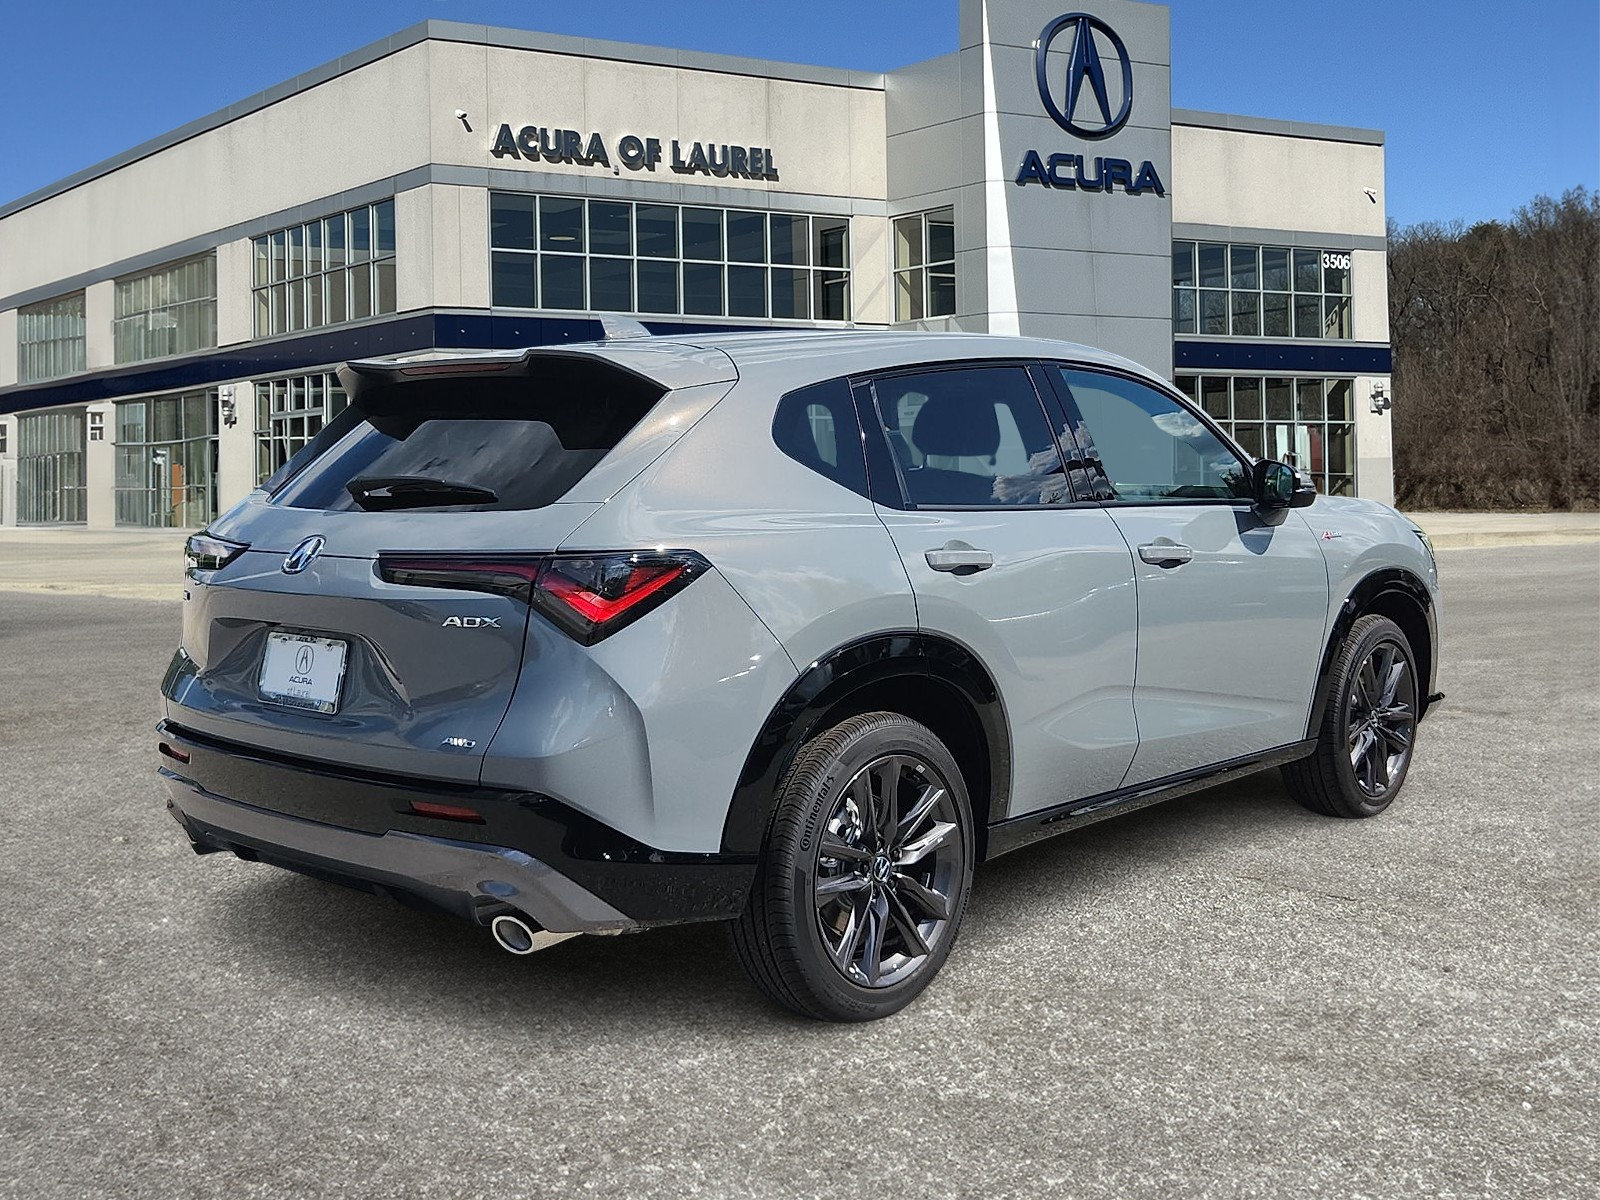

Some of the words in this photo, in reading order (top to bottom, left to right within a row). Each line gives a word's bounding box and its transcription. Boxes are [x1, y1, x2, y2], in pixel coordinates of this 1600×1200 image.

[492, 123, 610, 167] ACURA
[617, 135, 662, 170] OF
[671, 139, 778, 181] LAUREL
[1015, 150, 1165, 198] ACURA
[1323, 253, 1351, 270] 3506
[441, 616, 502, 628] ADX
[288, 676, 313, 685] ACURA
[441, 737, 476, 748] AWD
